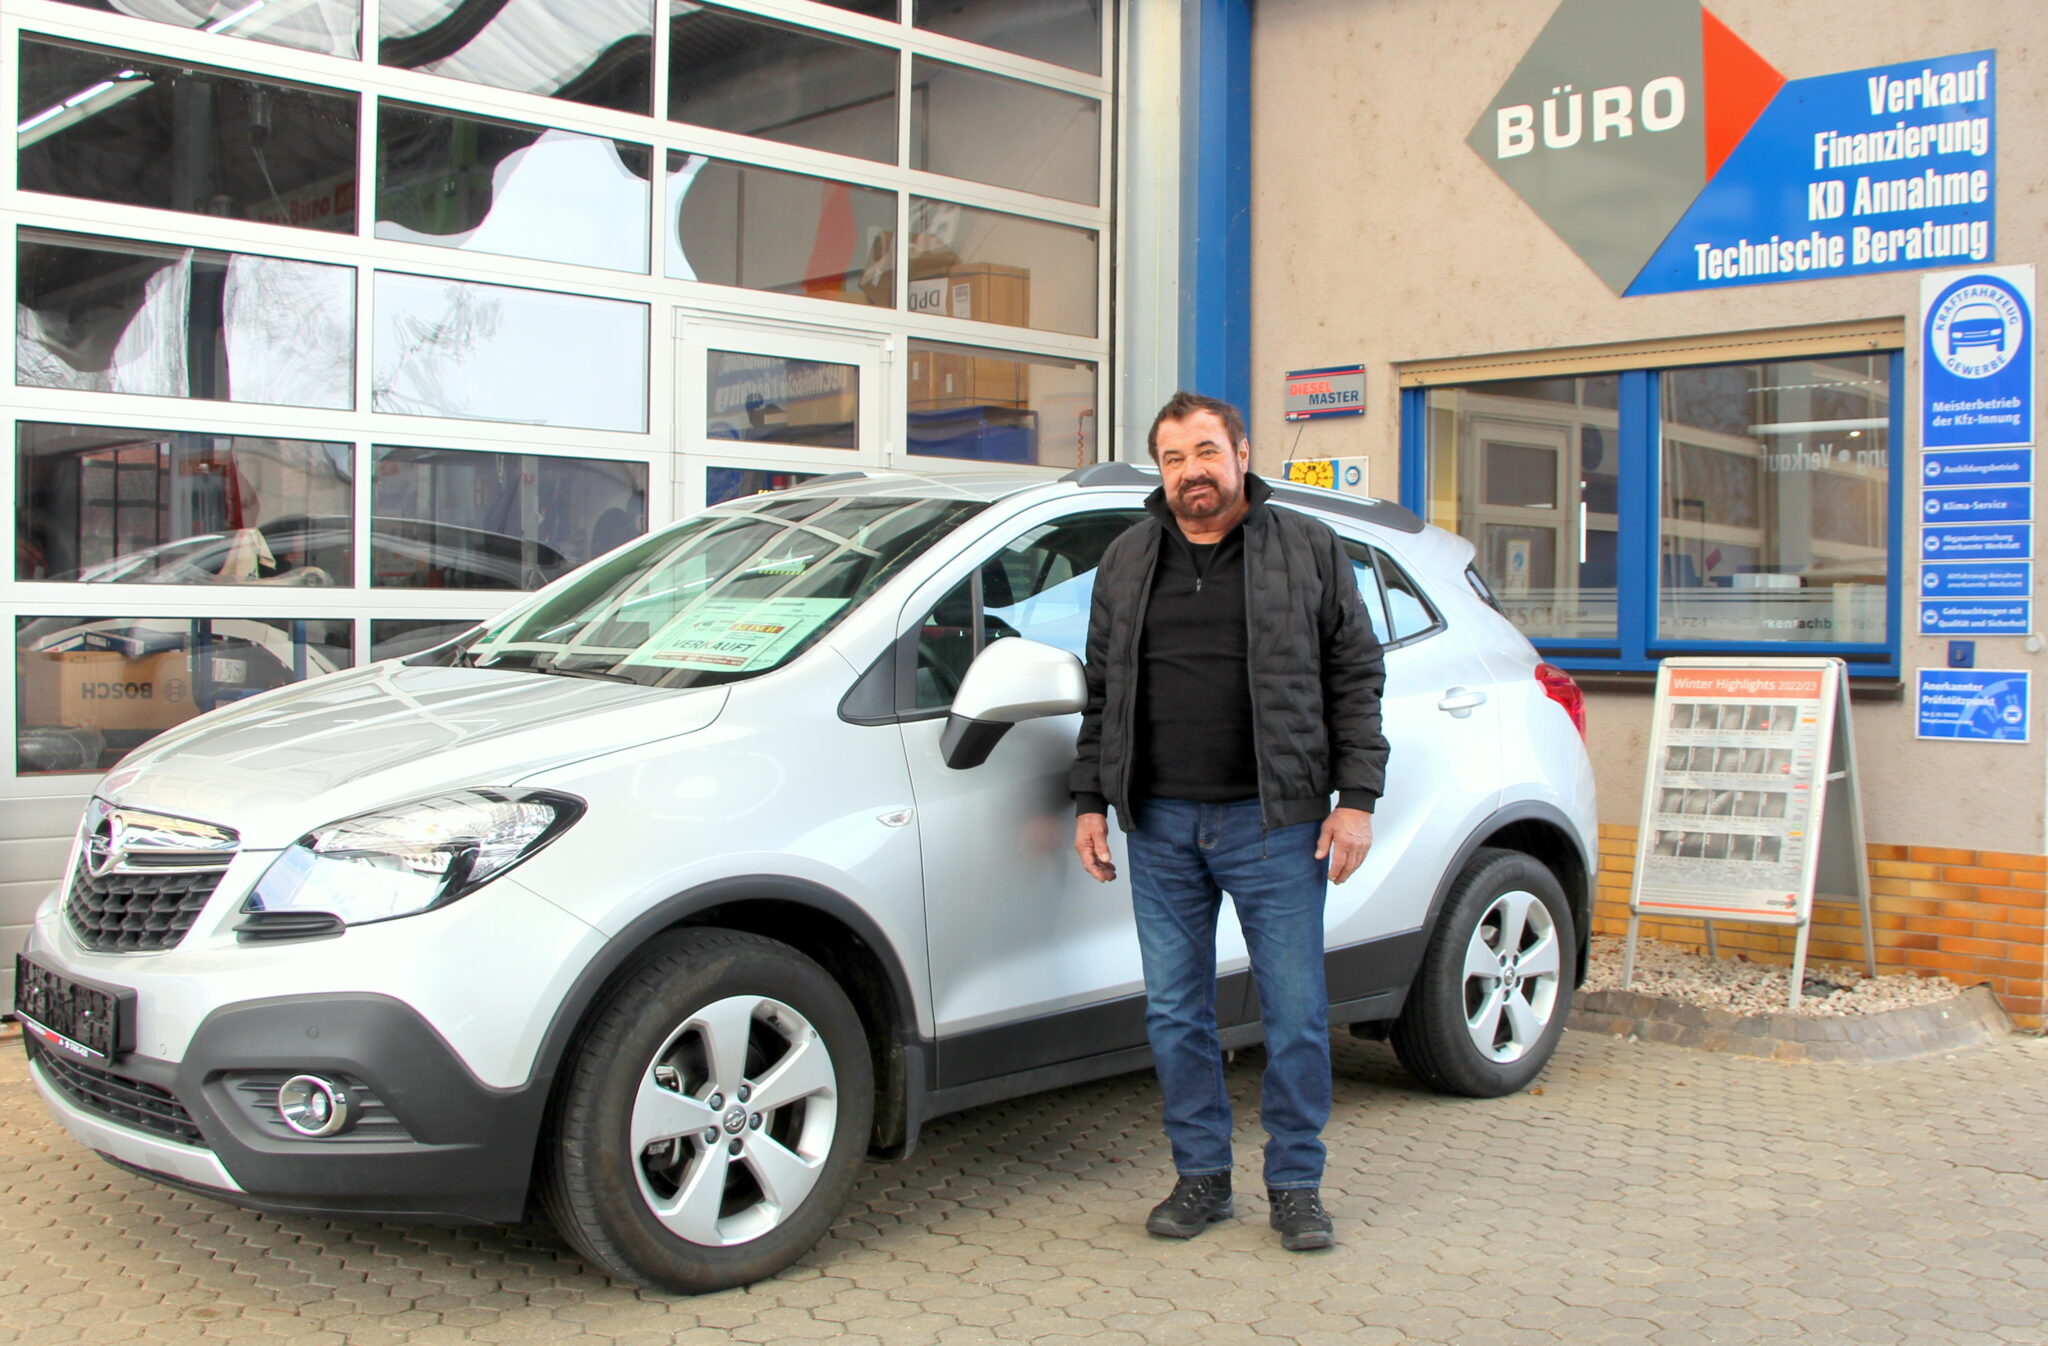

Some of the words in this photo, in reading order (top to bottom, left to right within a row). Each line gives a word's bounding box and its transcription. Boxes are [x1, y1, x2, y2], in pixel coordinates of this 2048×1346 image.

[1867, 60, 1989, 116] Verkauf
[1497, 75, 1685, 159] BÜRO
[1813, 115, 1988, 170] Finanzierung
[1808, 179, 1845, 222] KD
[1852, 169, 1988, 216] Annahme
[1694, 231, 1844, 281] Technische
[1851, 220, 1988, 266] Beratung
[1935, 287, 2019, 331] KRAFTFAHRZEUG
[1946, 354, 2006, 376] GEWERBE
[1289, 380, 1334, 396] DIESEL
[1308, 390, 1359, 406] MASTER
[1932, 397, 2020, 412] Meisterbetrieb
[1932, 415, 1953, 427] der
[1954, 413, 2020, 426] Kfz-Innung
[1942, 500, 2008, 511] Klima-Service
[672, 639, 757, 653] VERKAUFT
[81, 682, 153, 700] BOSCH
[1674, 677, 1713, 689] Winter
[1716, 678, 1776, 693] Highlights
[1778, 680, 1817, 691] 2022/23
